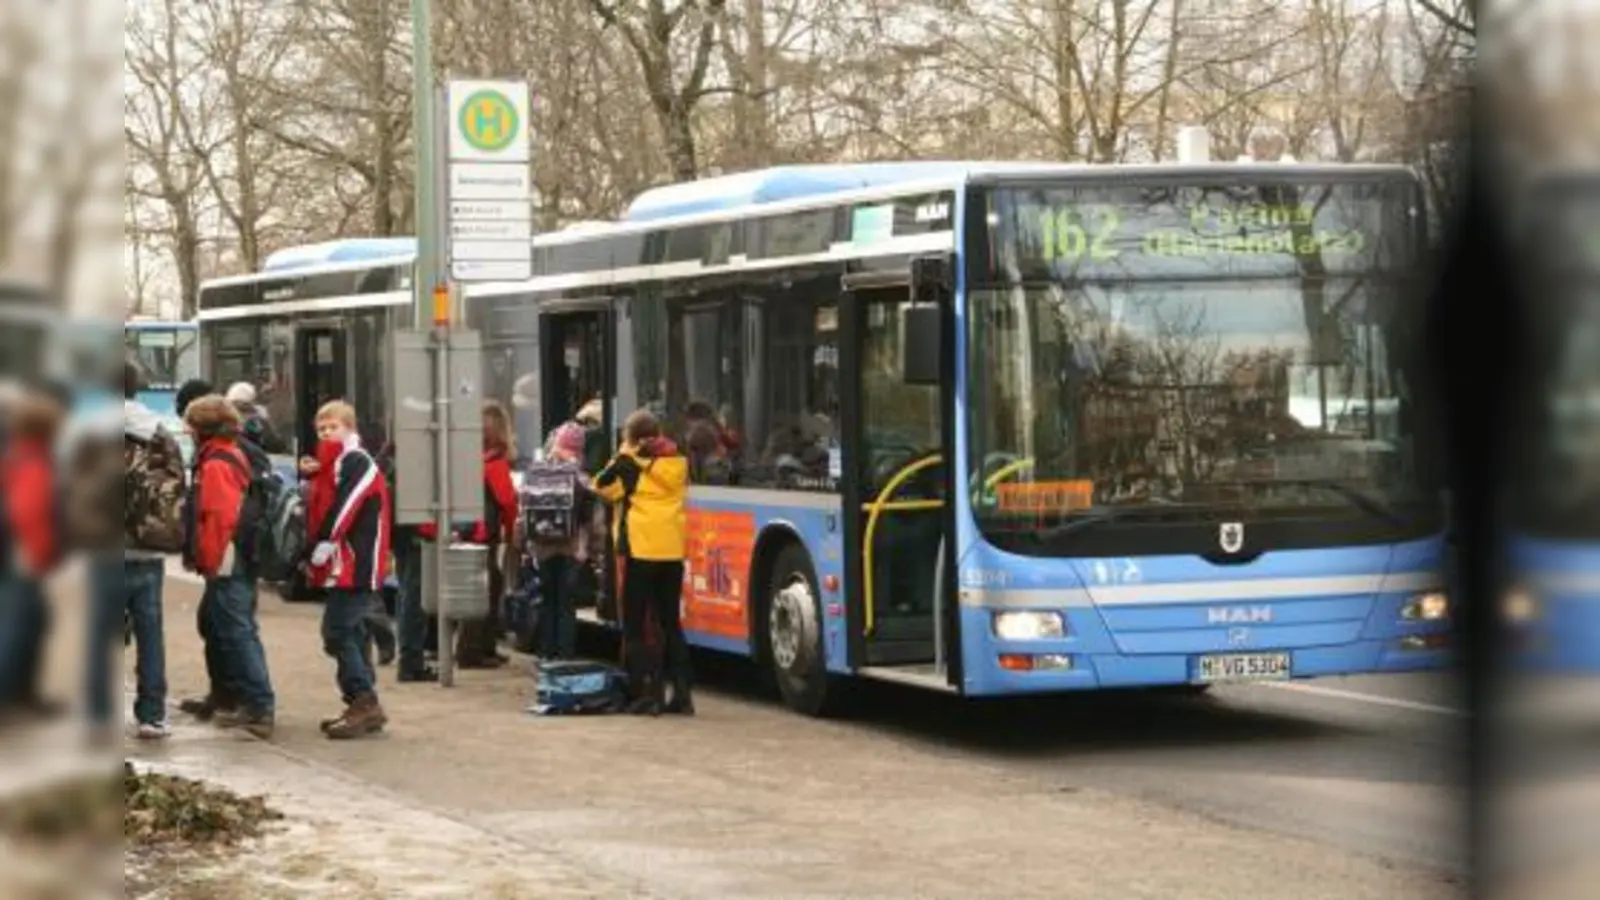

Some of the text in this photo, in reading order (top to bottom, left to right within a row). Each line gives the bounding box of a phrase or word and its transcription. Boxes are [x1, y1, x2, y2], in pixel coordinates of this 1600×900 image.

[475, 105, 502, 139] H
[915, 203, 949, 222] MAN
[1042, 205, 1122, 262] 162
[1207, 605, 1272, 623] MAN
